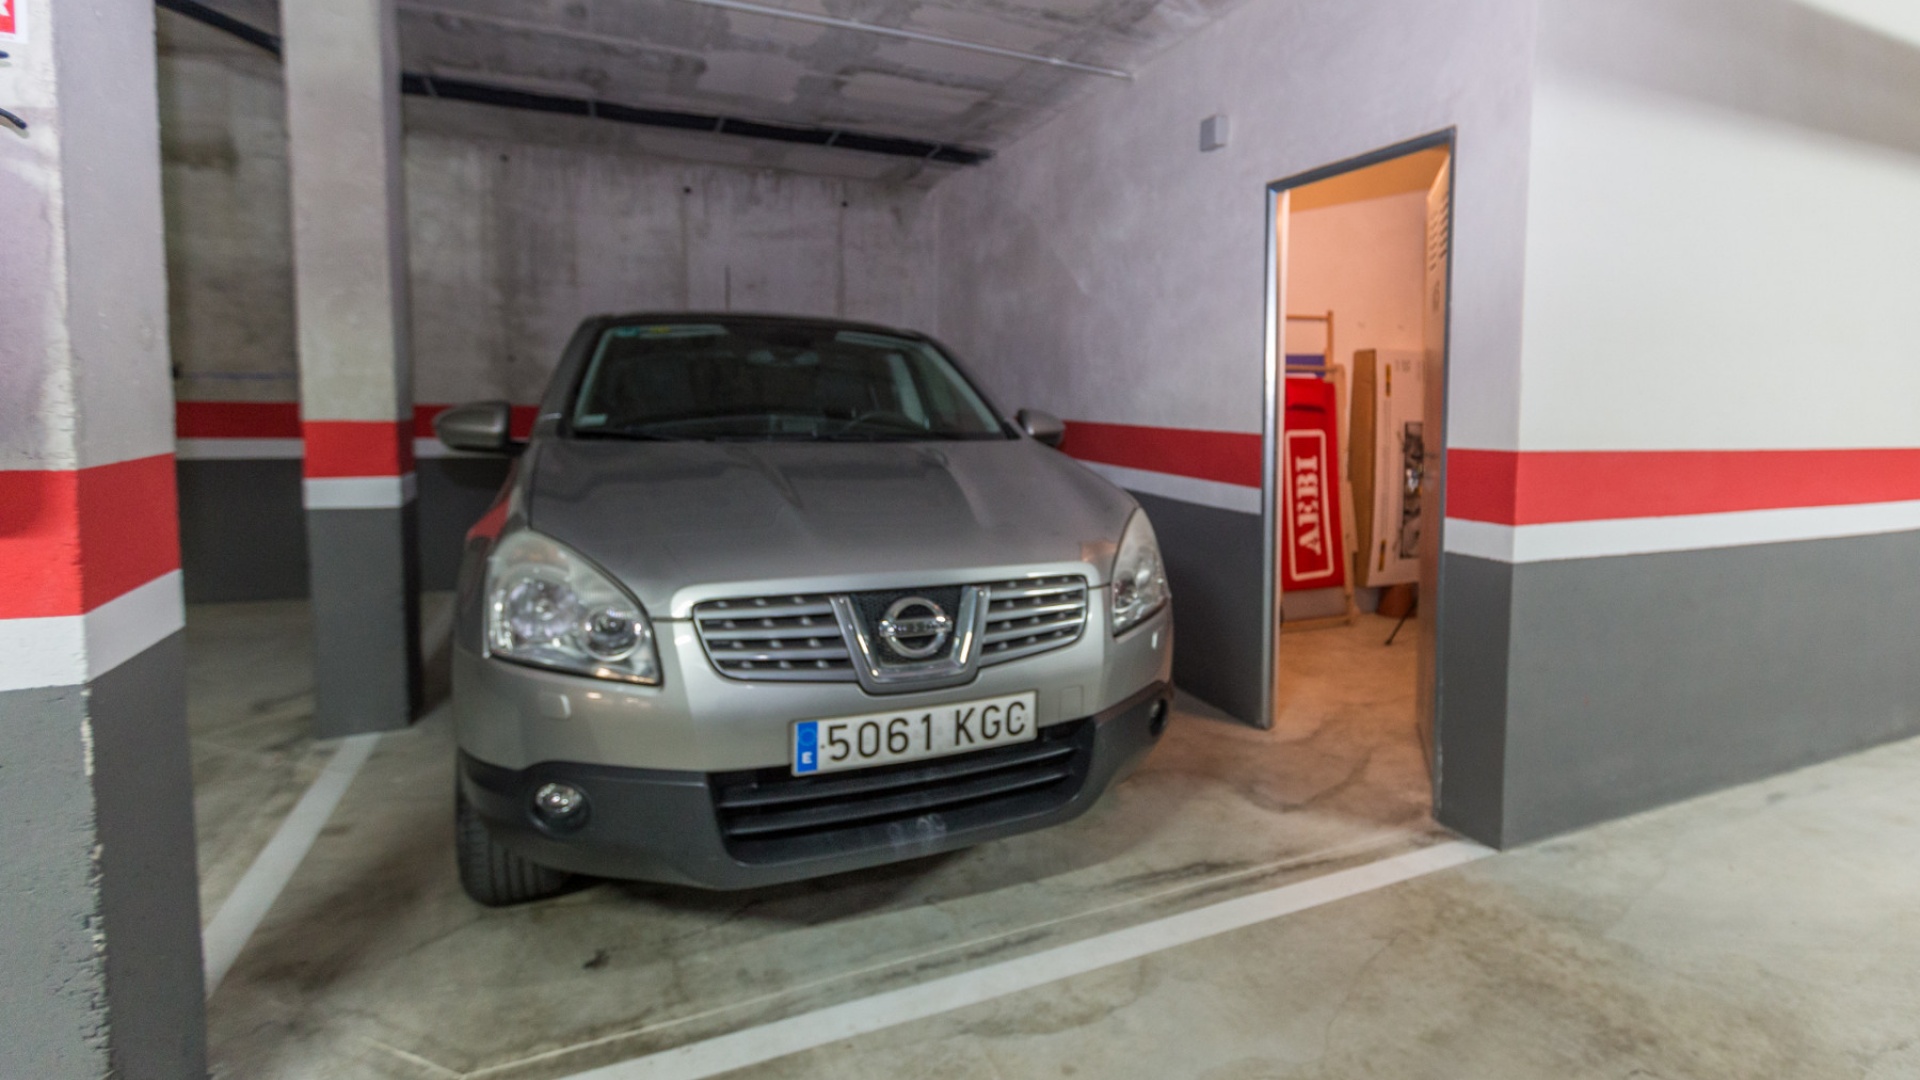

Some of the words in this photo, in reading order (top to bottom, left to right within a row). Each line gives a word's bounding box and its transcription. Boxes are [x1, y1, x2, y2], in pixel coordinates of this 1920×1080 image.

[1295, 455, 1322, 556] AEBI
[801, 751, 813, 764] E
[827, 713, 932, 762] 5061
[954, 701, 1026, 746] KGC
